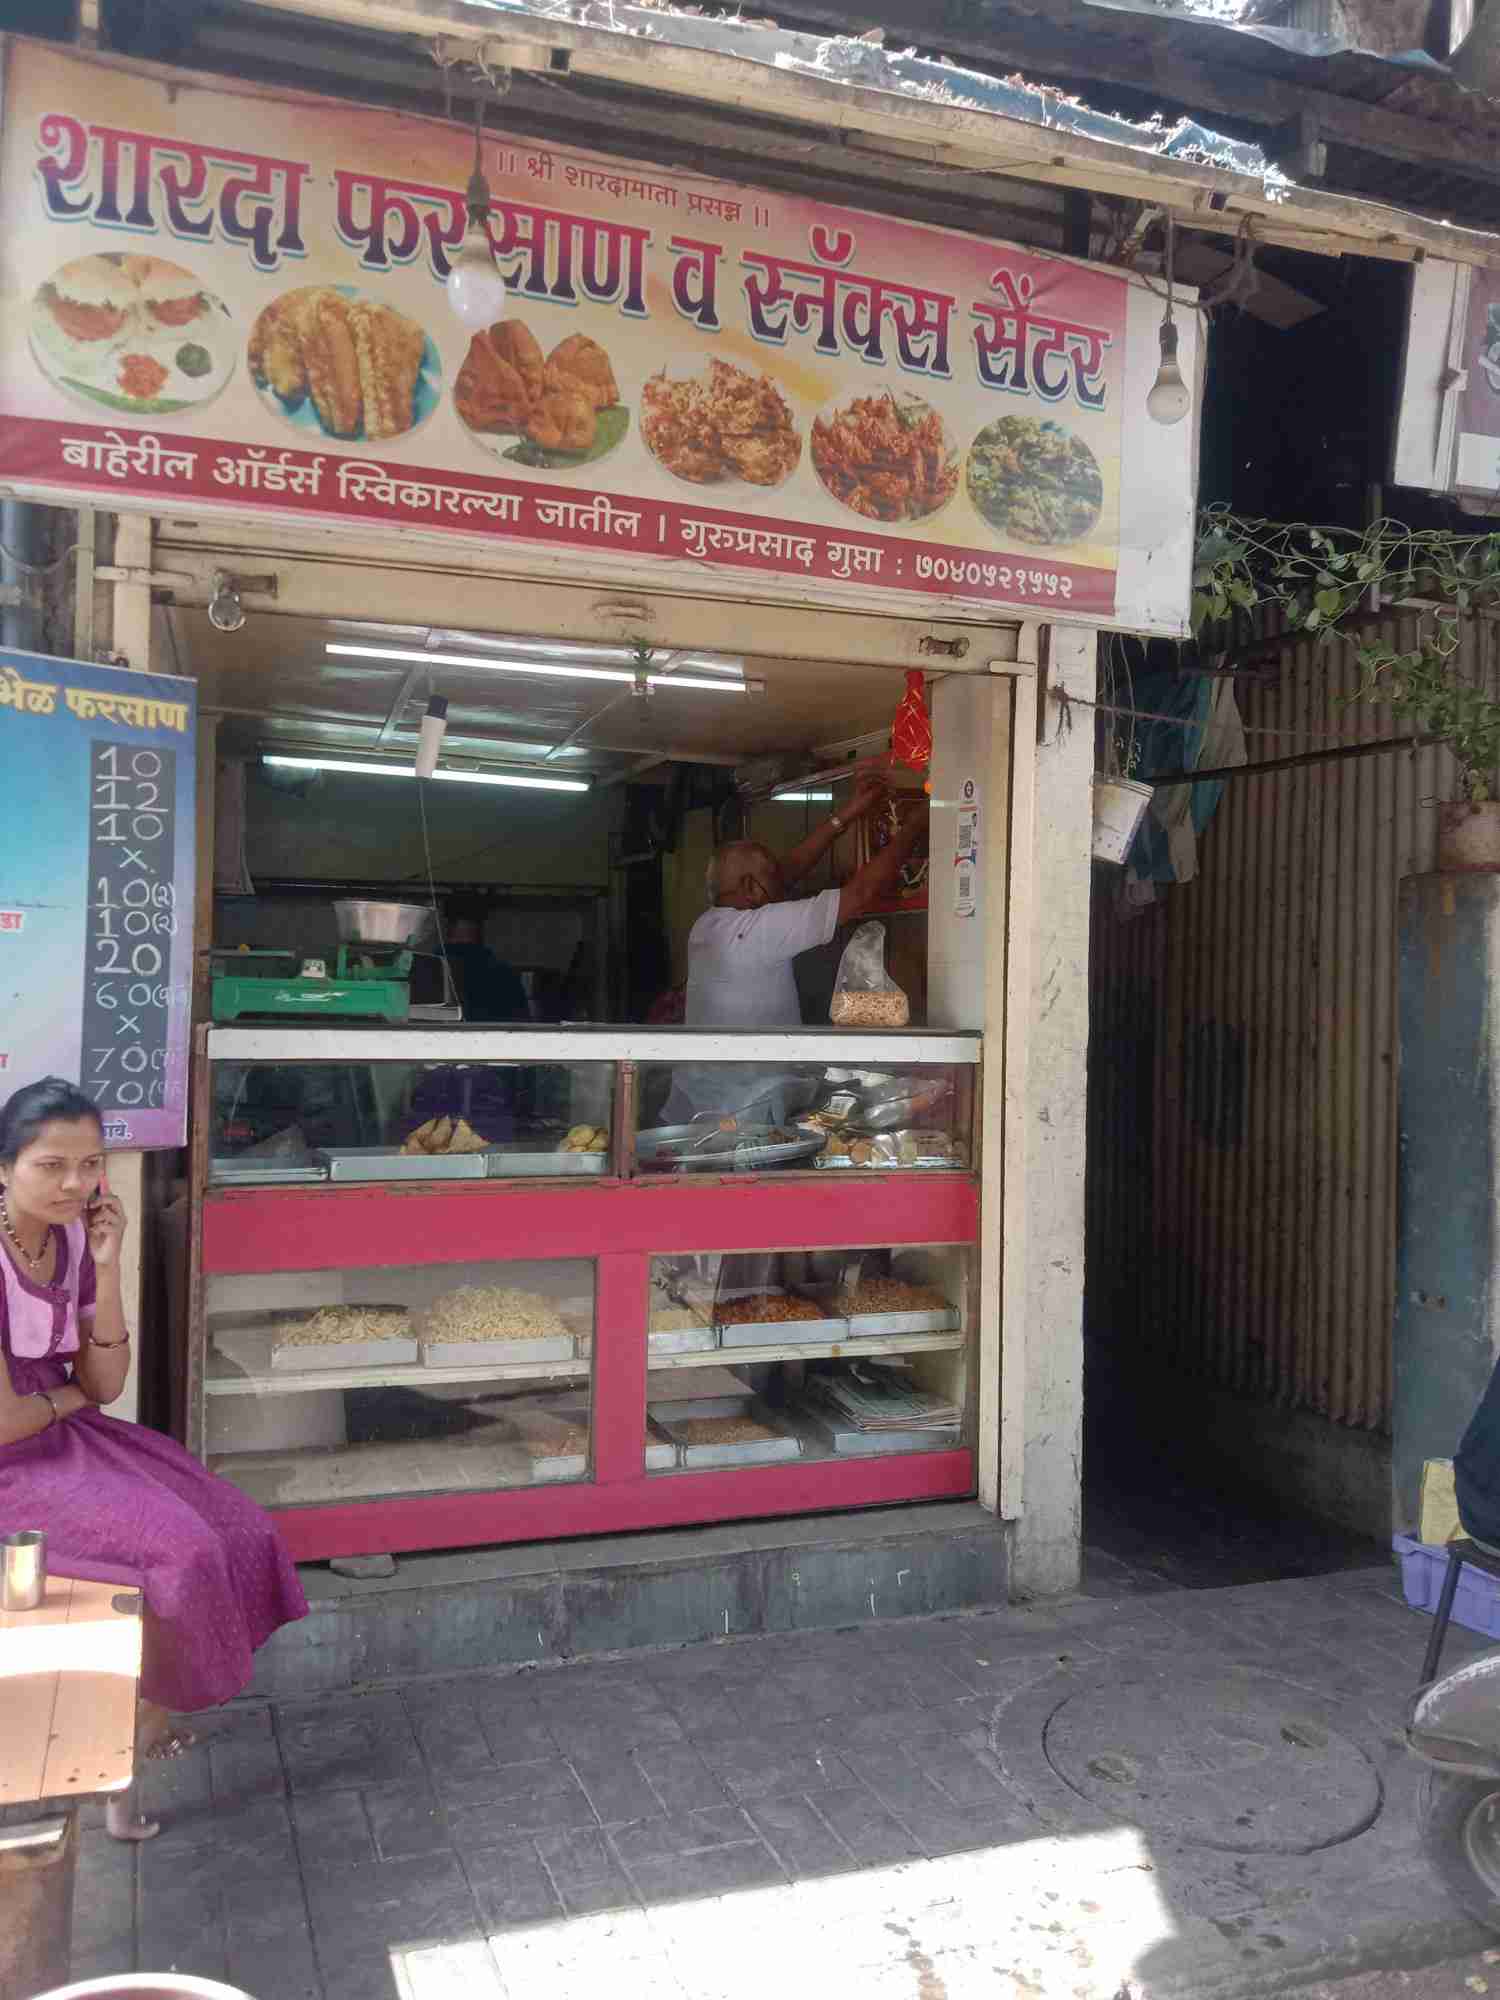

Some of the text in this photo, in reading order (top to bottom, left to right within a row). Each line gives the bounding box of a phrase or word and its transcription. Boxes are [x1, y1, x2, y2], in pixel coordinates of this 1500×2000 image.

[526, 151, 556, 182] श्री
[564, 164, 679, 211] शारदामाता
[686, 191, 743, 224] प्रसन्न
[36, 112, 313, 270] शारदा
[334, 169, 652, 314] फरसाण
[668, 235, 724, 330] व
[968, 268, 1112, 411] सेंटर
[60, 430, 197, 481] बाहेरील
[212, 446, 324, 496] ऑर्डर्स
[336, 460, 524, 522] स्विकारल्या
[535, 495, 641, 539] जातील
[826, 540, 885, 579] गुप्ता
[914, 553, 1074, 600] ७०४०५२१५५२
[64, 686, 189, 733] फरसाण
[94, 938, 162, 976] 20
